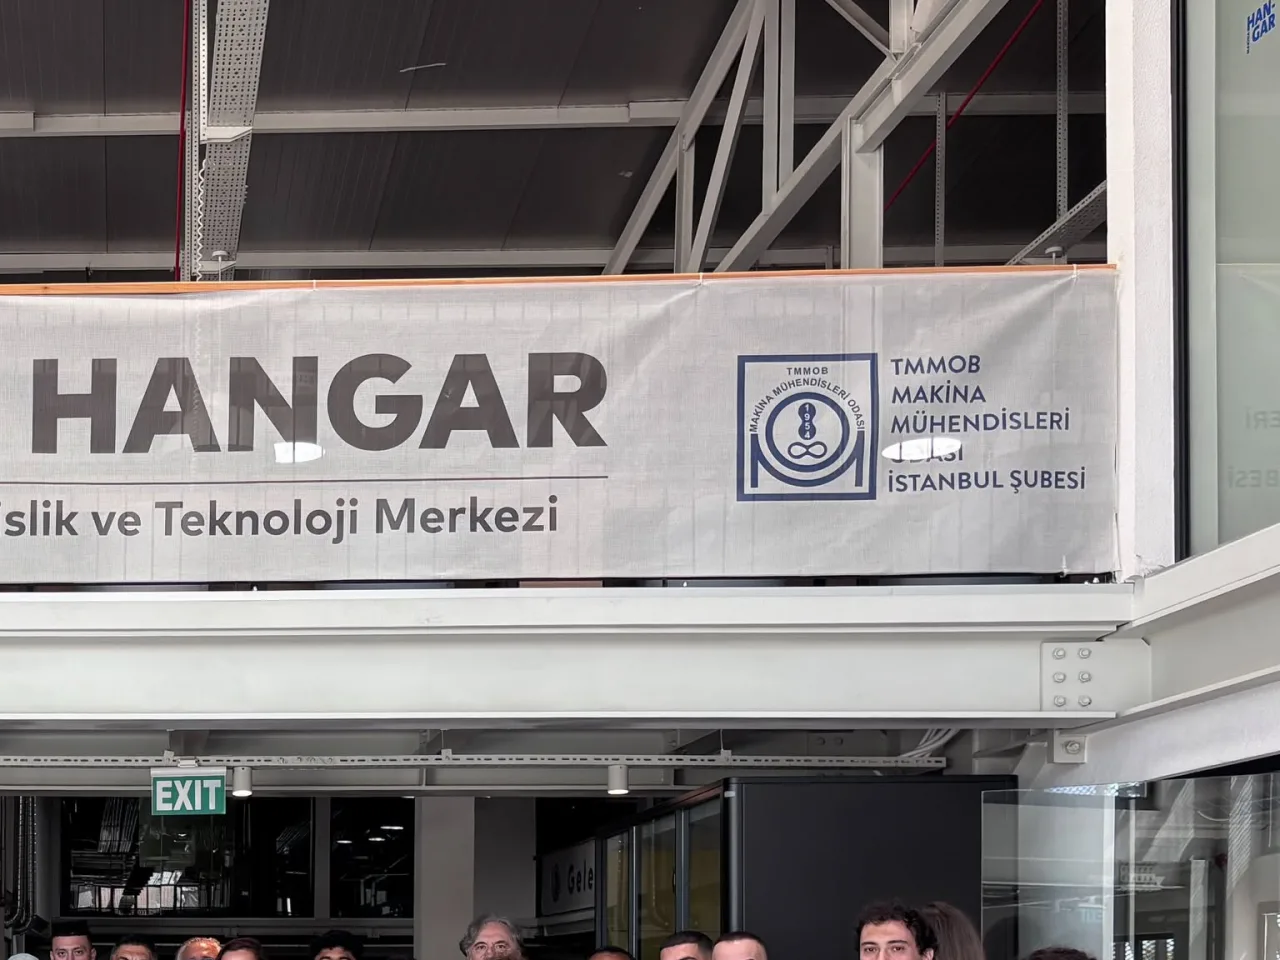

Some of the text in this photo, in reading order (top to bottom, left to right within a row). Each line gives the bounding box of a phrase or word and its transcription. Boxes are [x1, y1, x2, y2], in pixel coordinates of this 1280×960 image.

[1252, 13, 1276, 42] GAR
[786, 366, 829, 375] TMMOB
[890, 355, 981, 375] TMMOB
[31, 351, 608, 454] HANGAR
[749, 377, 865, 433] MAKİNA MÜHENDİSLERİ ODASI
[891, 379, 987, 404] MAKİNA
[890, 407, 1070, 434] MÜHENDİSLERİ
[888, 466, 1086, 494] İSTANBUL ŞUBESİ
[92, 510, 142, 537] ve
[154, 497, 358, 544] Teknoloji
[375, 494, 559, 535] Merkezi
[156, 779, 222, 811] EXIT
